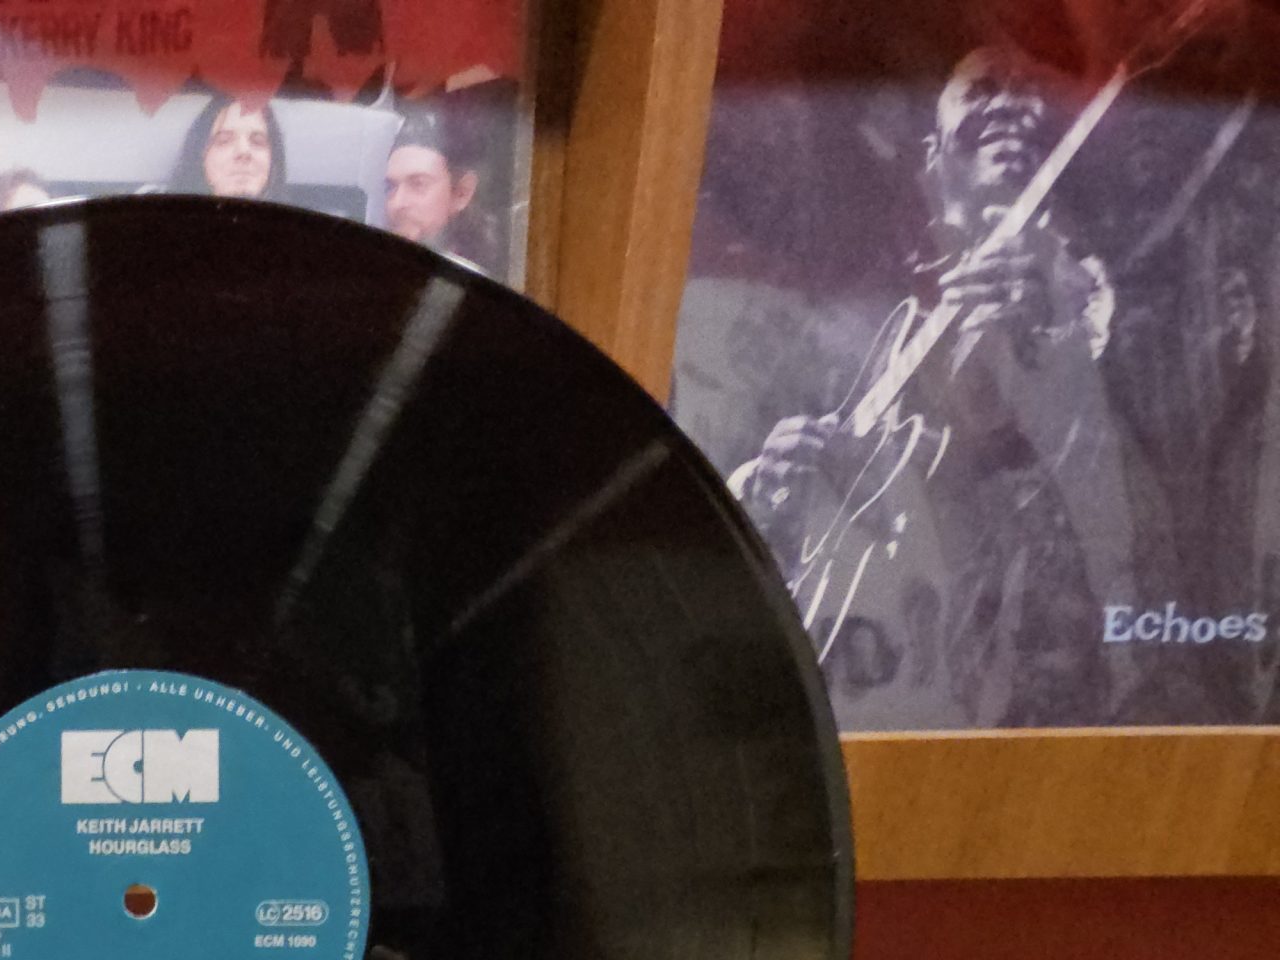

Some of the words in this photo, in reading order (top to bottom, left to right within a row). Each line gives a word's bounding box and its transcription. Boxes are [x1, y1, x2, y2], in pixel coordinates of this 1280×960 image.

[116, 9, 193, 57] KING
[1102, 600, 1269, 644] Echoes
[149, 681, 189, 698] ALLE
[271, 730, 302, 761] UND
[60, 728, 220, 805] ECM
[76, 818, 127, 834] KEITH
[129, 817, 205, 834] JARRETT
[88, 838, 192, 855] HOURGLASS
[282, 904, 323, 921] 2516
[254, 934, 285, 948] ECM
